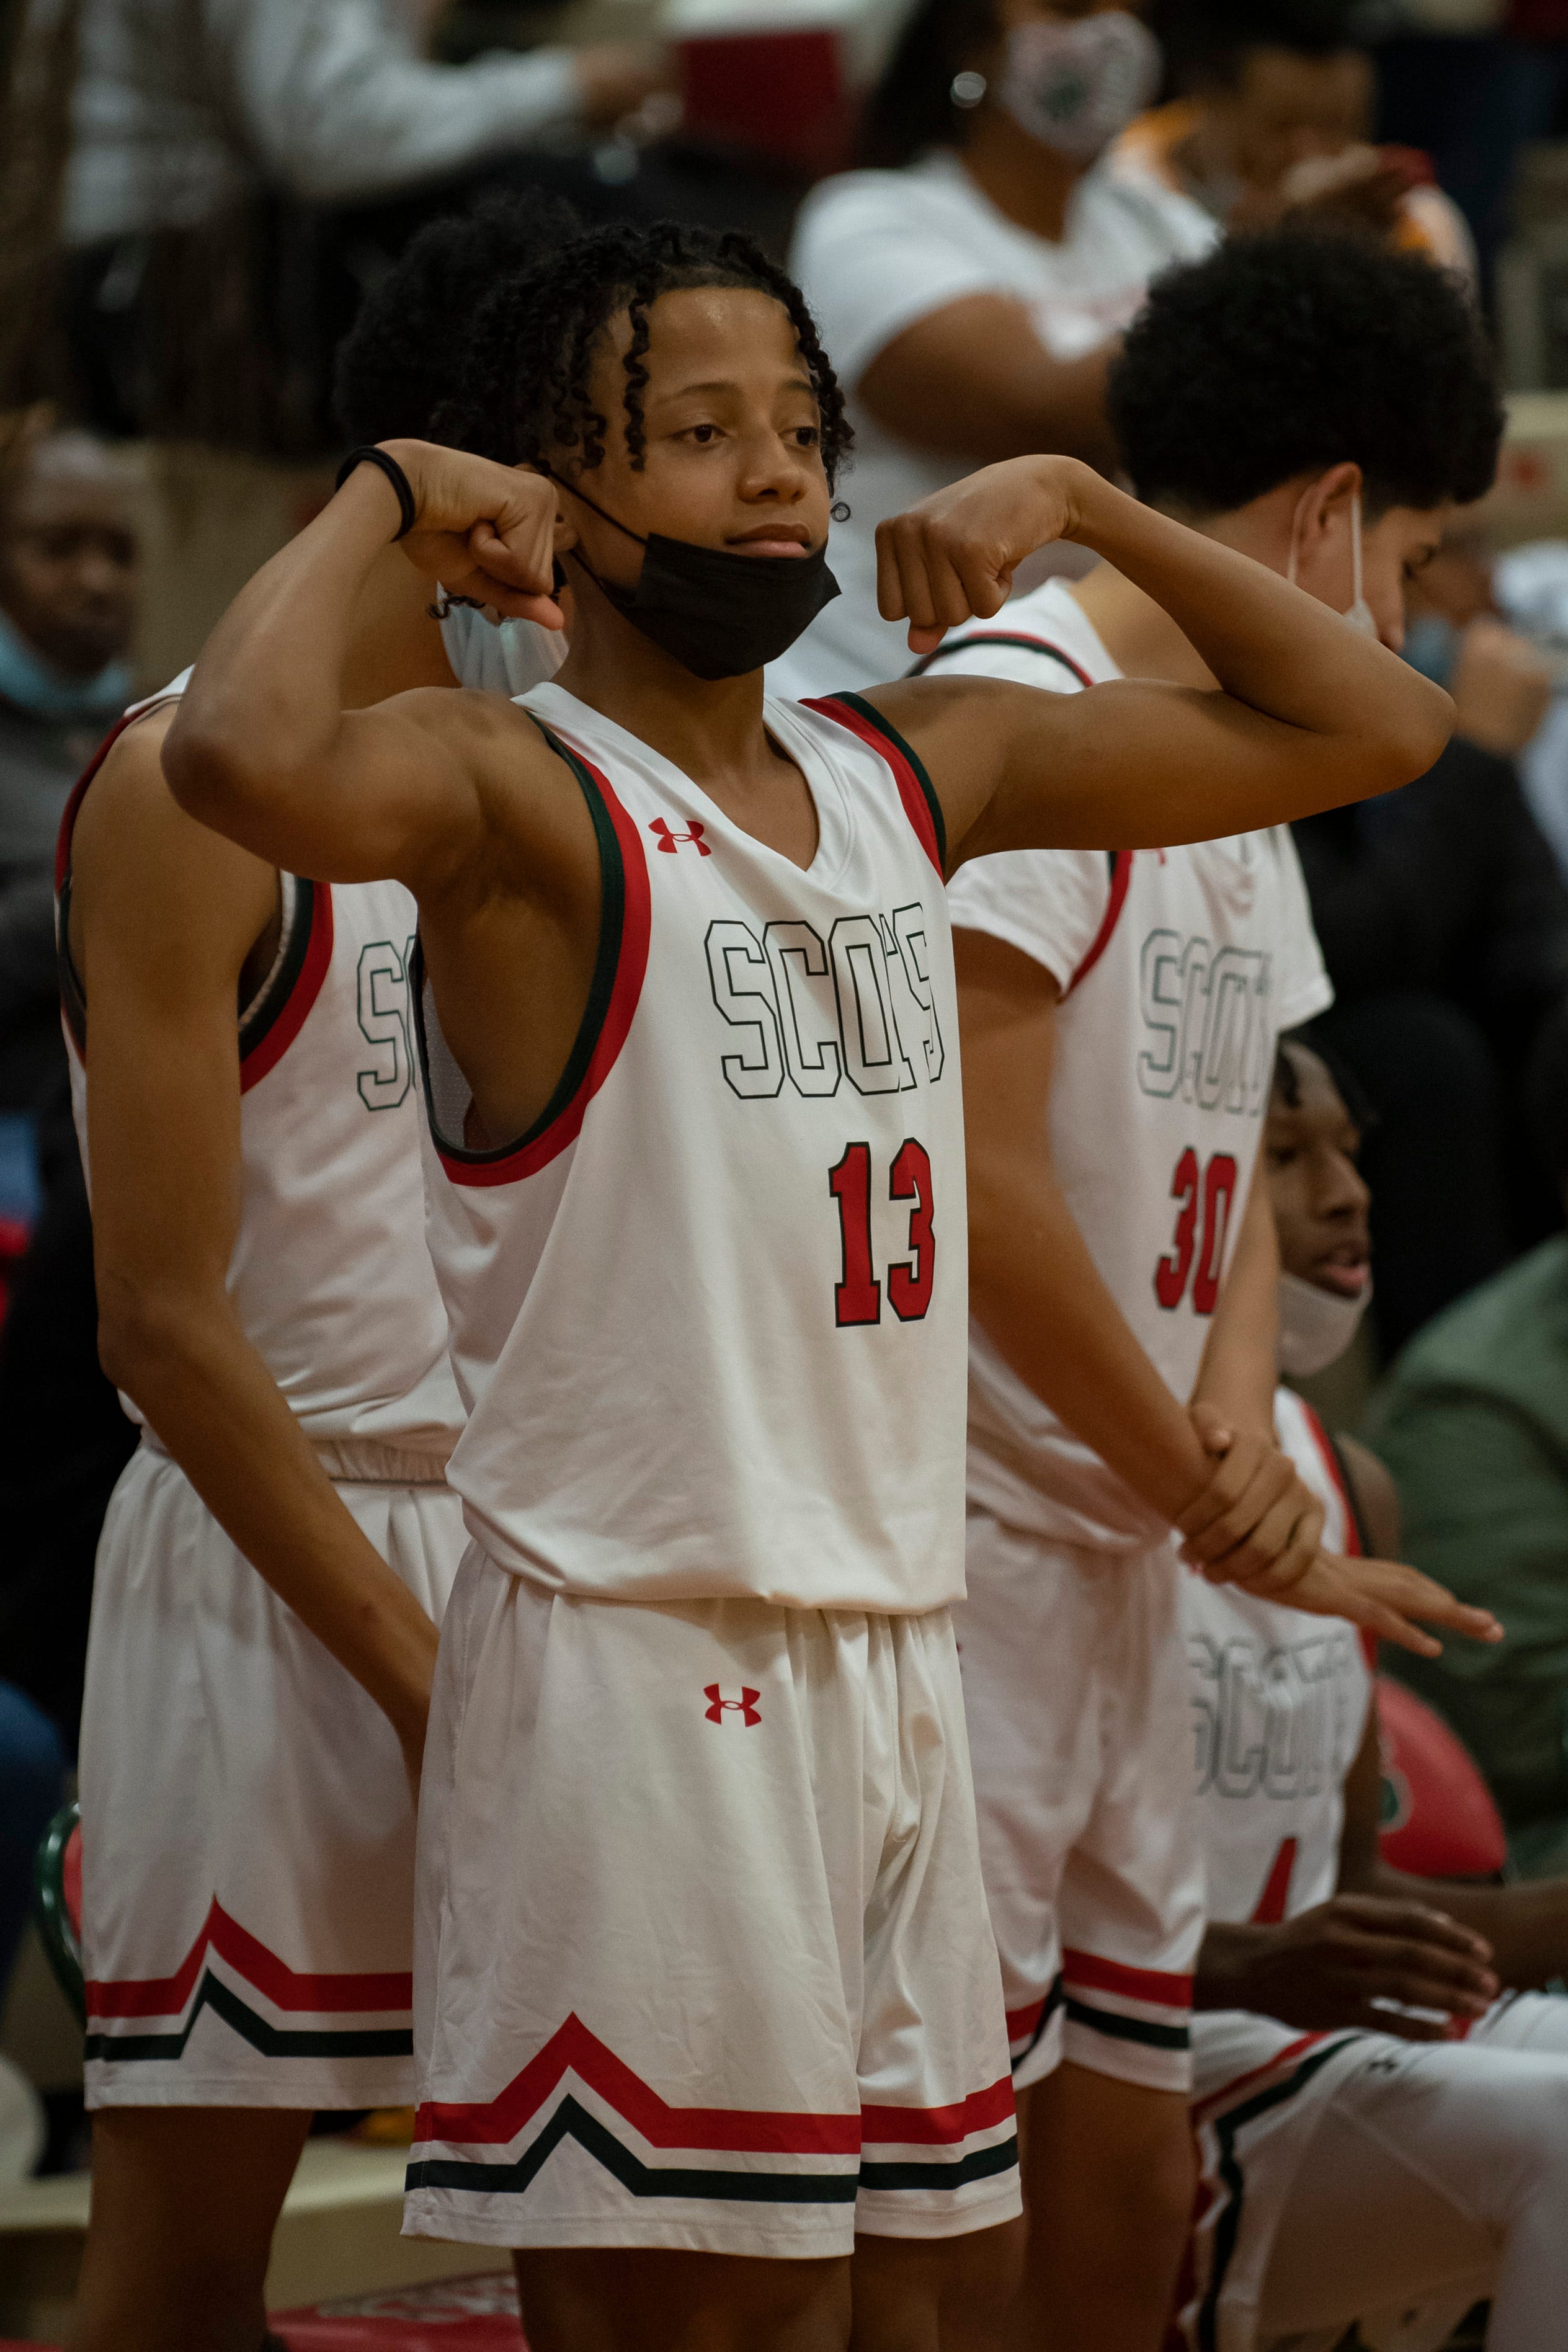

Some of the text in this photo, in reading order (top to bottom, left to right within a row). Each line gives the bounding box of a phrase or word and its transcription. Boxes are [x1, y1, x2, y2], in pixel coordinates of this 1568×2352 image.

[356, 934, 417, 1111] S
[1136, 927, 1273, 1117] SCOT
[827, 1137, 937, 1328] 13
[1154, 1145, 1237, 1316] 30
